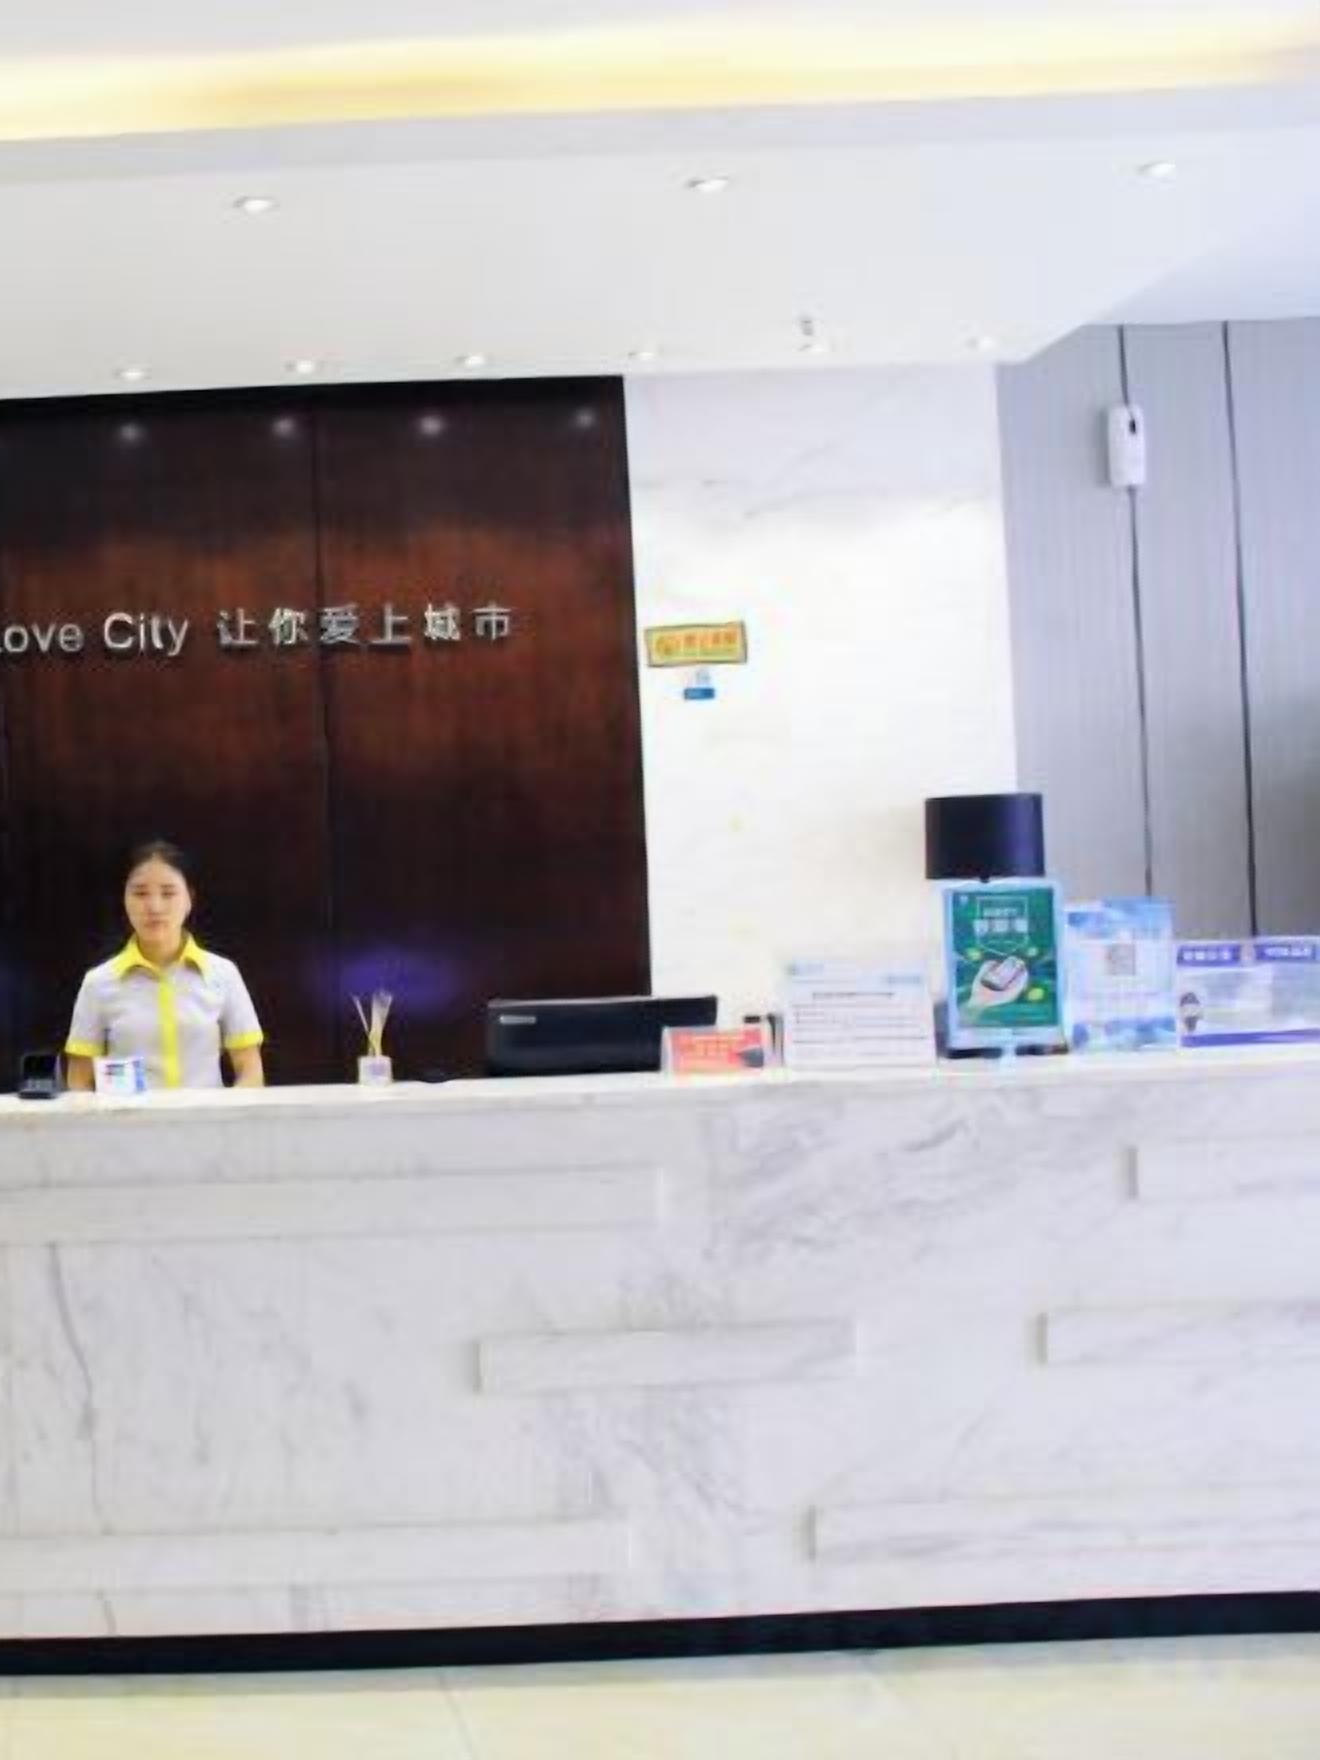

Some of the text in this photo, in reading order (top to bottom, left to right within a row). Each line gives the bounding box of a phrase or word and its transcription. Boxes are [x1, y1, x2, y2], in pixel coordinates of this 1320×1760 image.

[103, 611, 190, 657] City
[218, 602, 513, 647] 让你爱上城市
